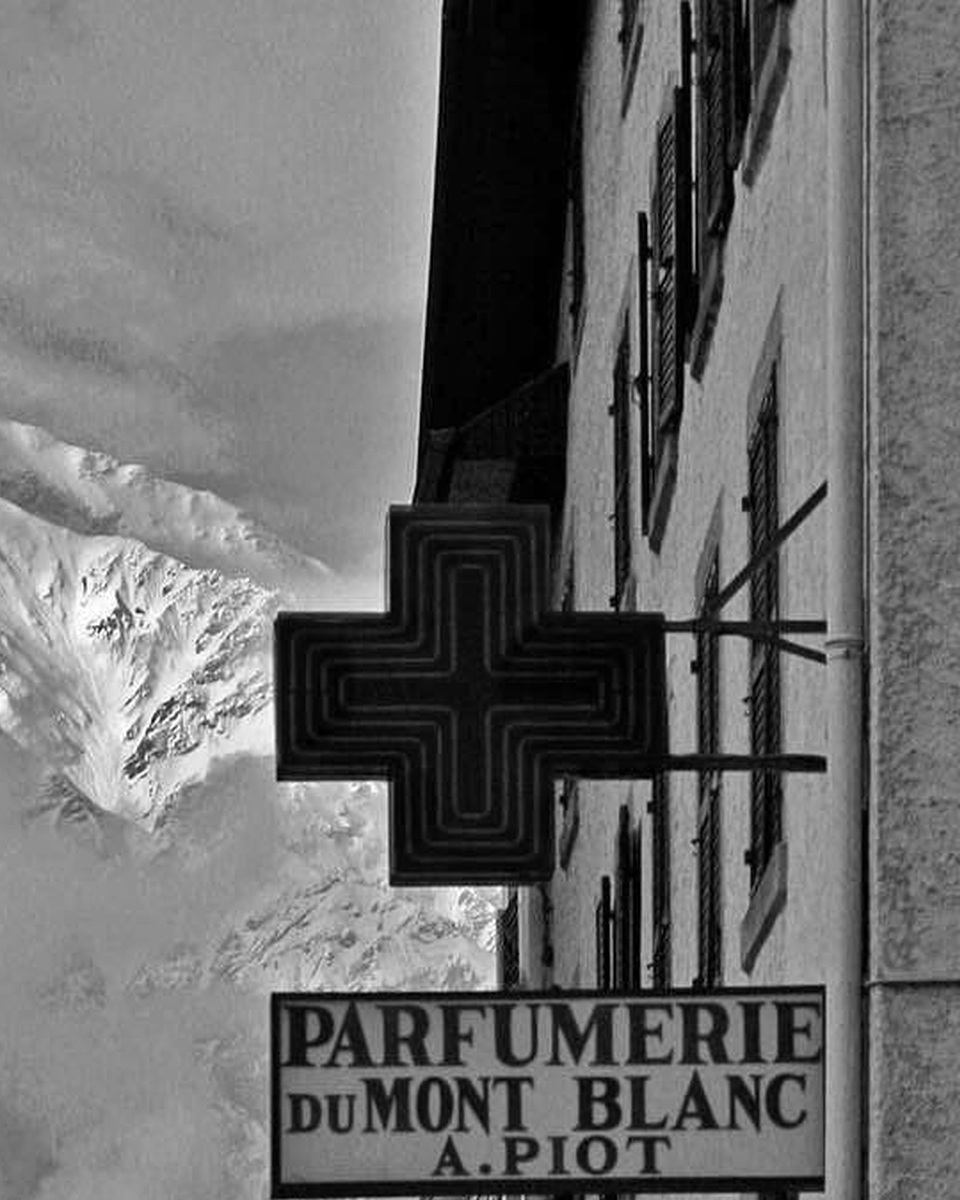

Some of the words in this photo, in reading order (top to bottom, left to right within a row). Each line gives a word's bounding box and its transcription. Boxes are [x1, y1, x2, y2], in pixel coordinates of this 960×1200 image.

[282, 1000, 823, 1068] PARFUMERIE
[286, 1092, 357, 1135] DU
[361, 1075, 535, 1135] MONT
[575, 1070, 809, 1133] BLANC
